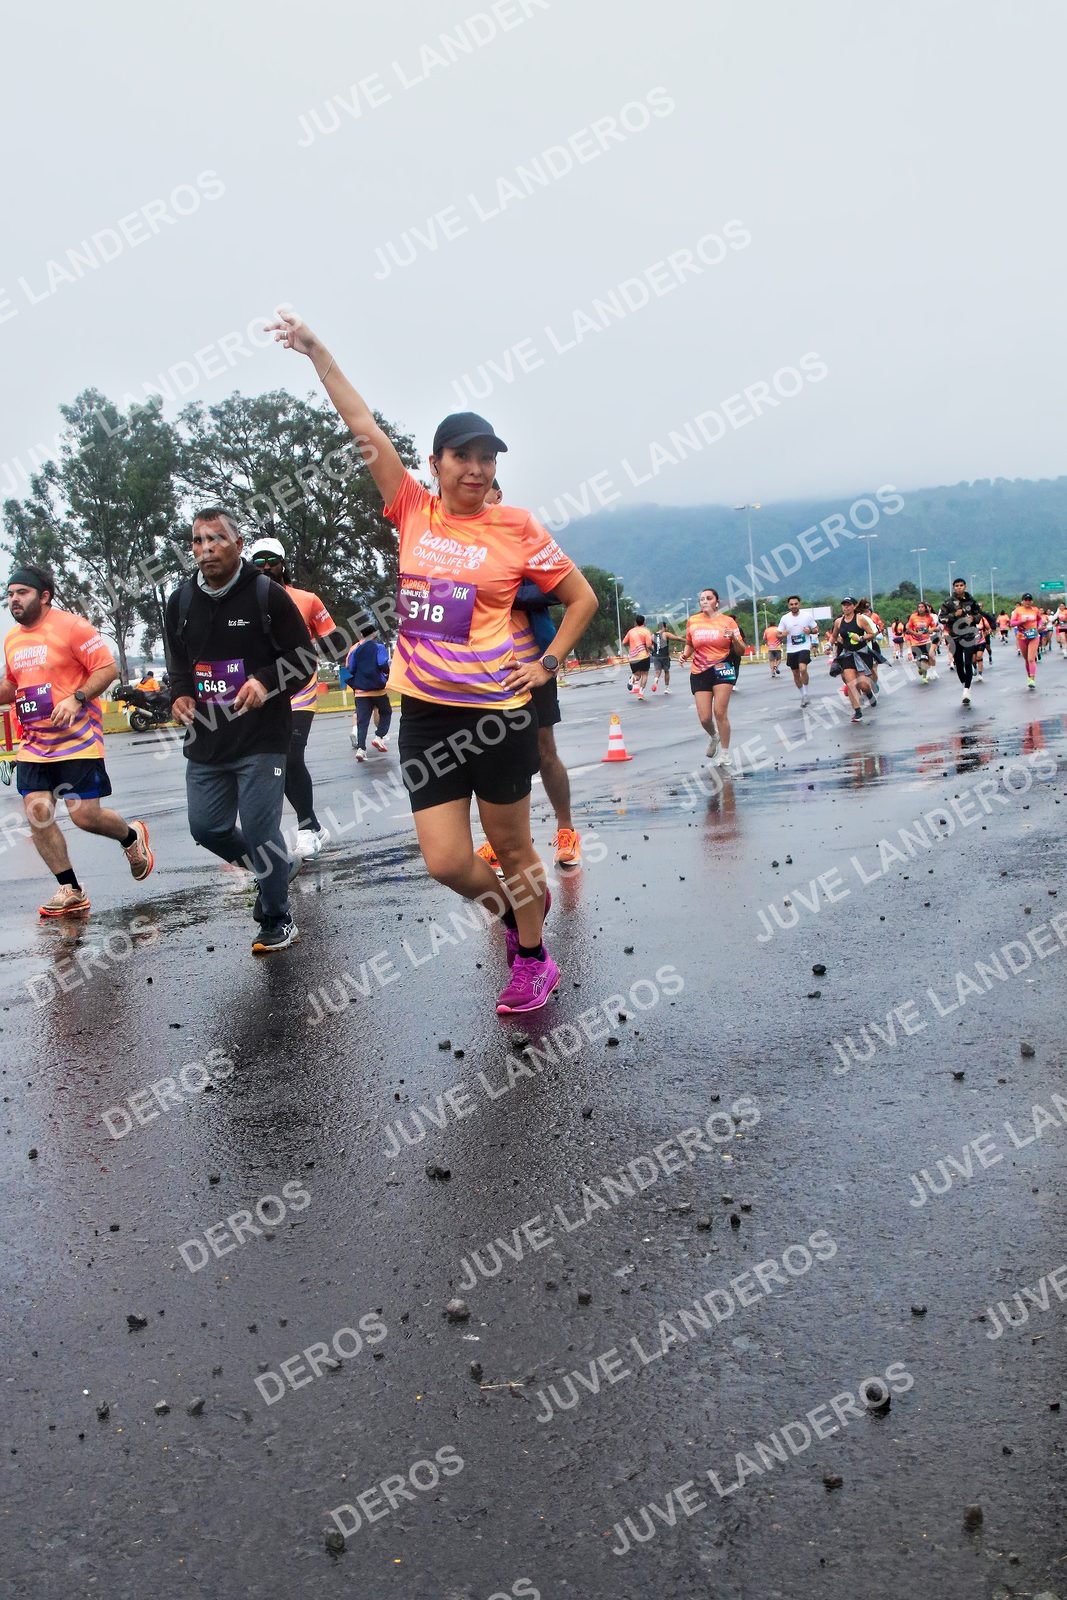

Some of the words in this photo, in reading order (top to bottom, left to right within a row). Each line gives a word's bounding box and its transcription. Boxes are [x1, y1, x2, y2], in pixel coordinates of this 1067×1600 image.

[412, 545, 466, 568] OMNILIFE
[408, 601, 444, 623] 318
[204, 679, 227, 693] 648
[20, 701, 38, 714] 182
